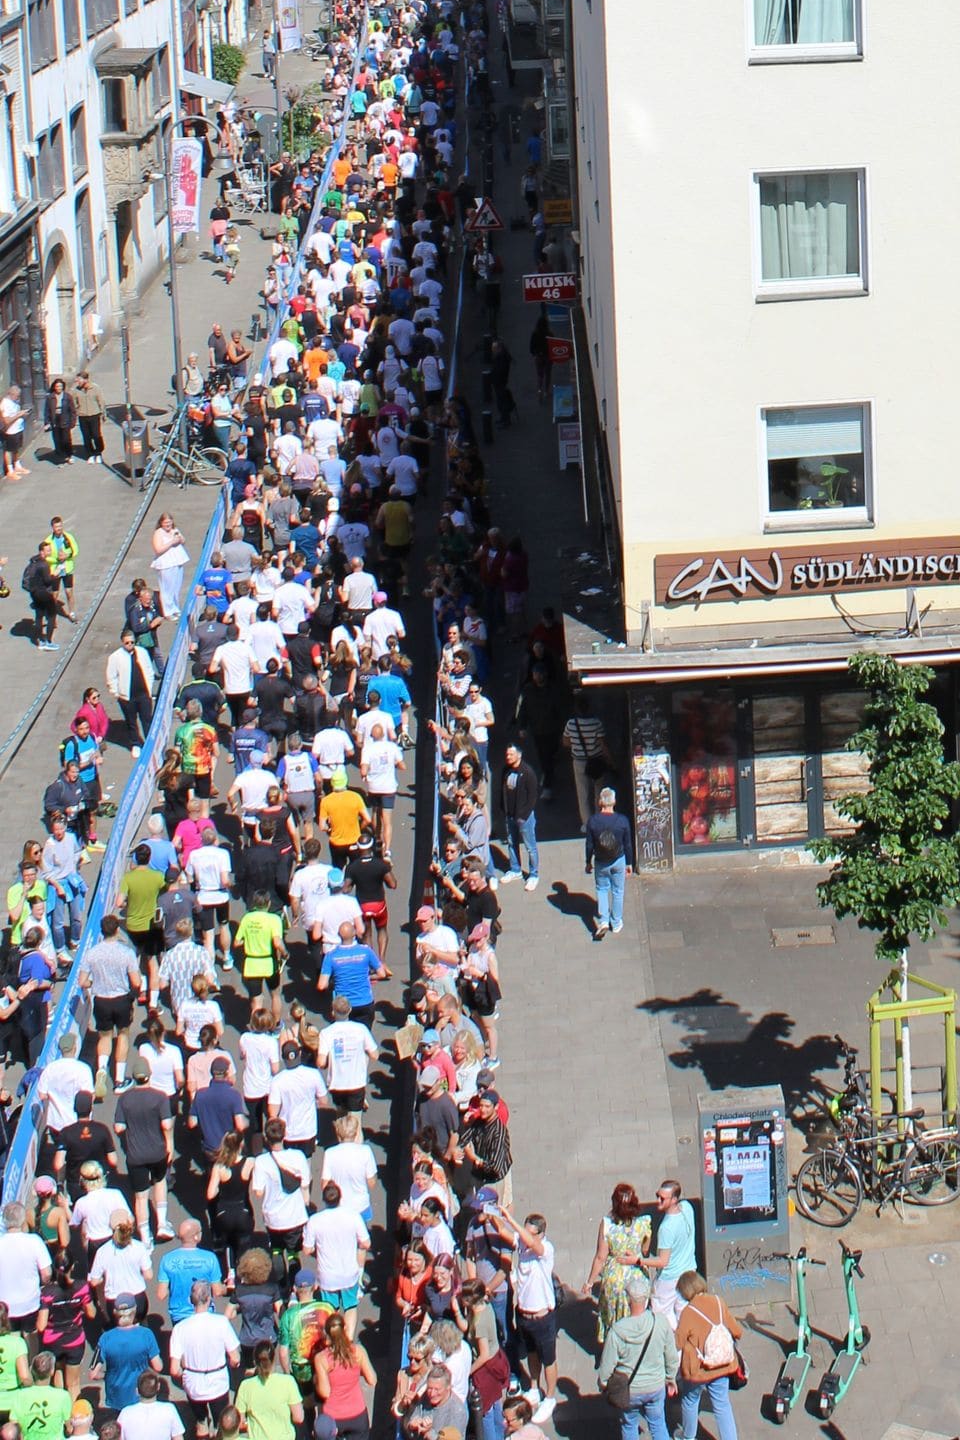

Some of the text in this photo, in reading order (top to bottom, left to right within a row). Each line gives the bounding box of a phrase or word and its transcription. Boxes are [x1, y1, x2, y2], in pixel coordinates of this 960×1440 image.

[525, 275, 575, 289] KIOSK
[542, 288, 560, 299] 46
[668, 551, 784, 600] CAN
[713, 1109, 771, 1121] Chlodwigplatz
[737, 1150, 767, 1161] MAI
